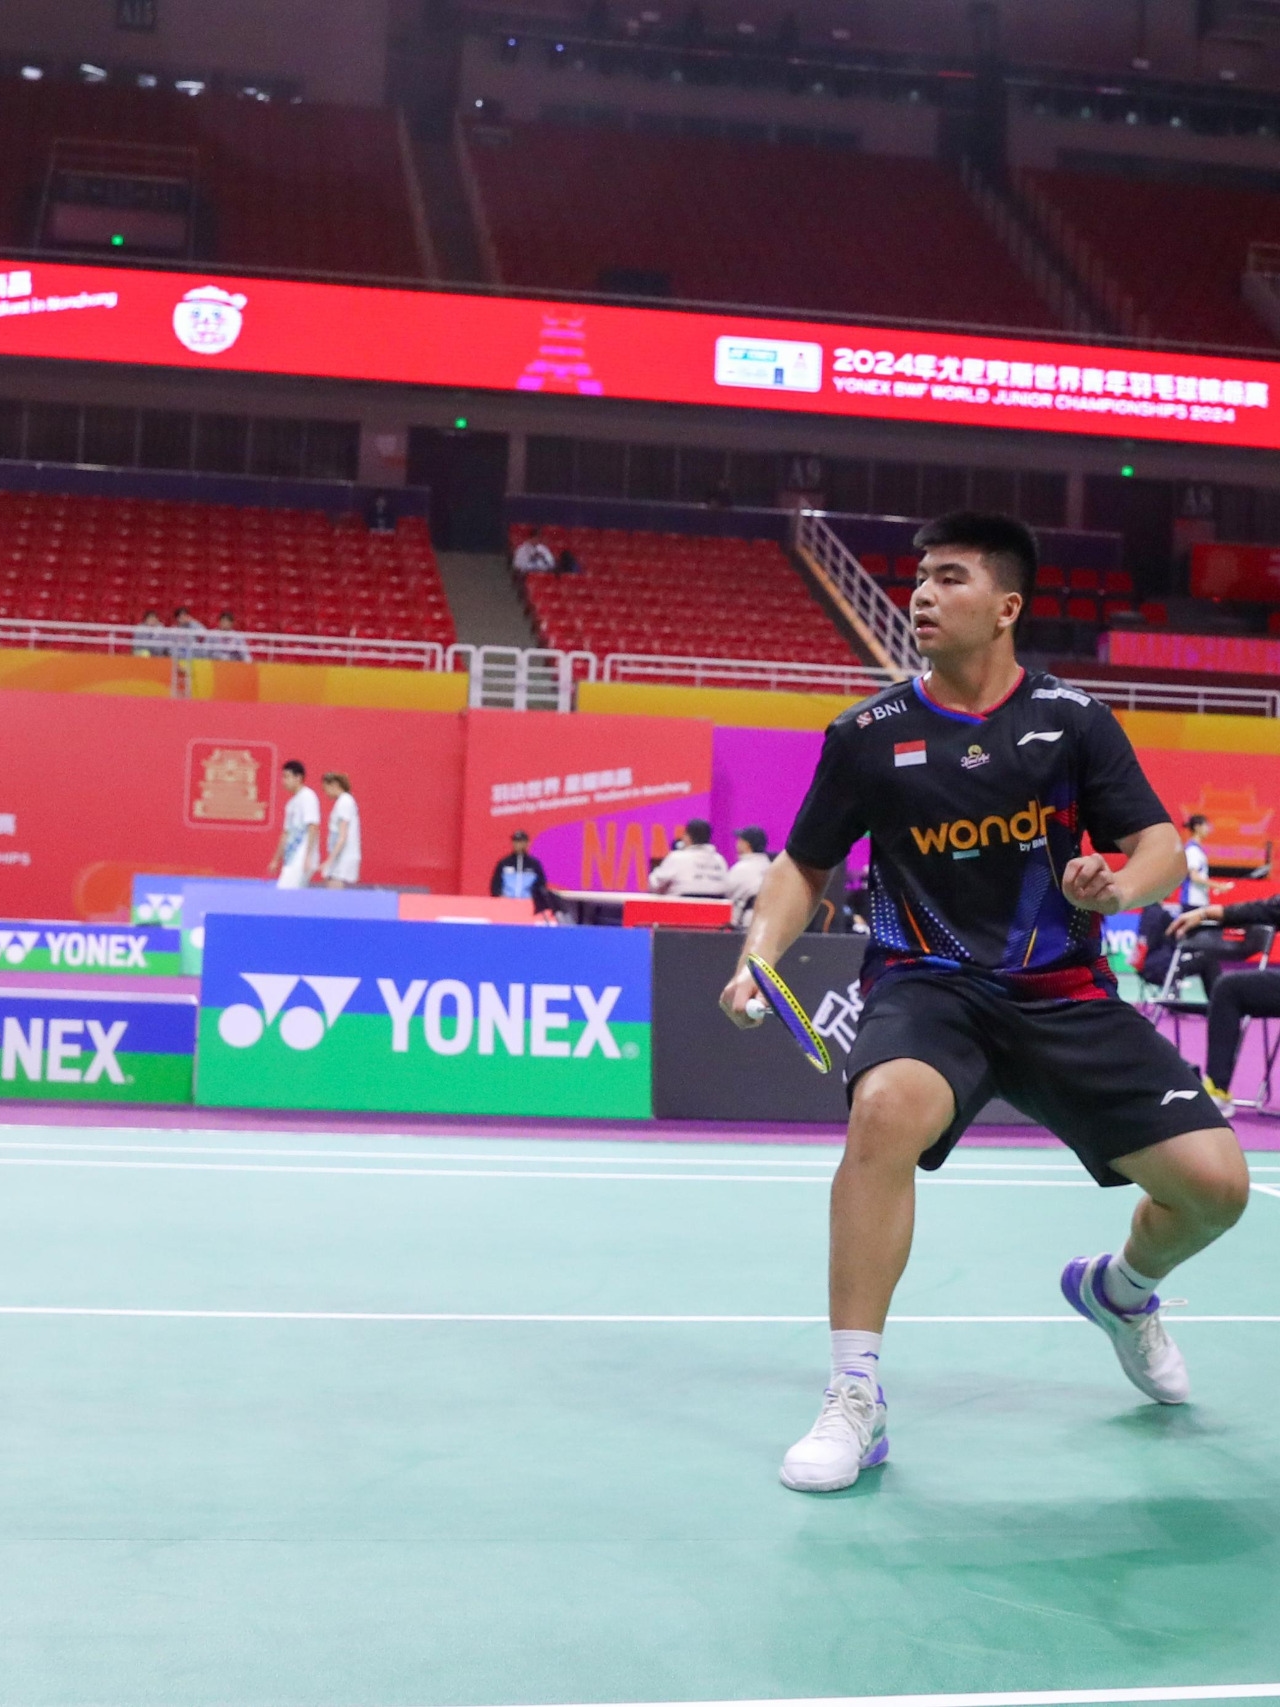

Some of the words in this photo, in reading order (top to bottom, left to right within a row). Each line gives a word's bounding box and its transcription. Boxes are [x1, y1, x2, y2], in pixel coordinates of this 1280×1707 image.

[872, 700, 907, 721] BNI
[910, 800, 1055, 855] wondr
[1019, 842, 1031, 852] by
[45, 932, 147, 968] YONEX
[376, 978, 622, 1059] YONEX
